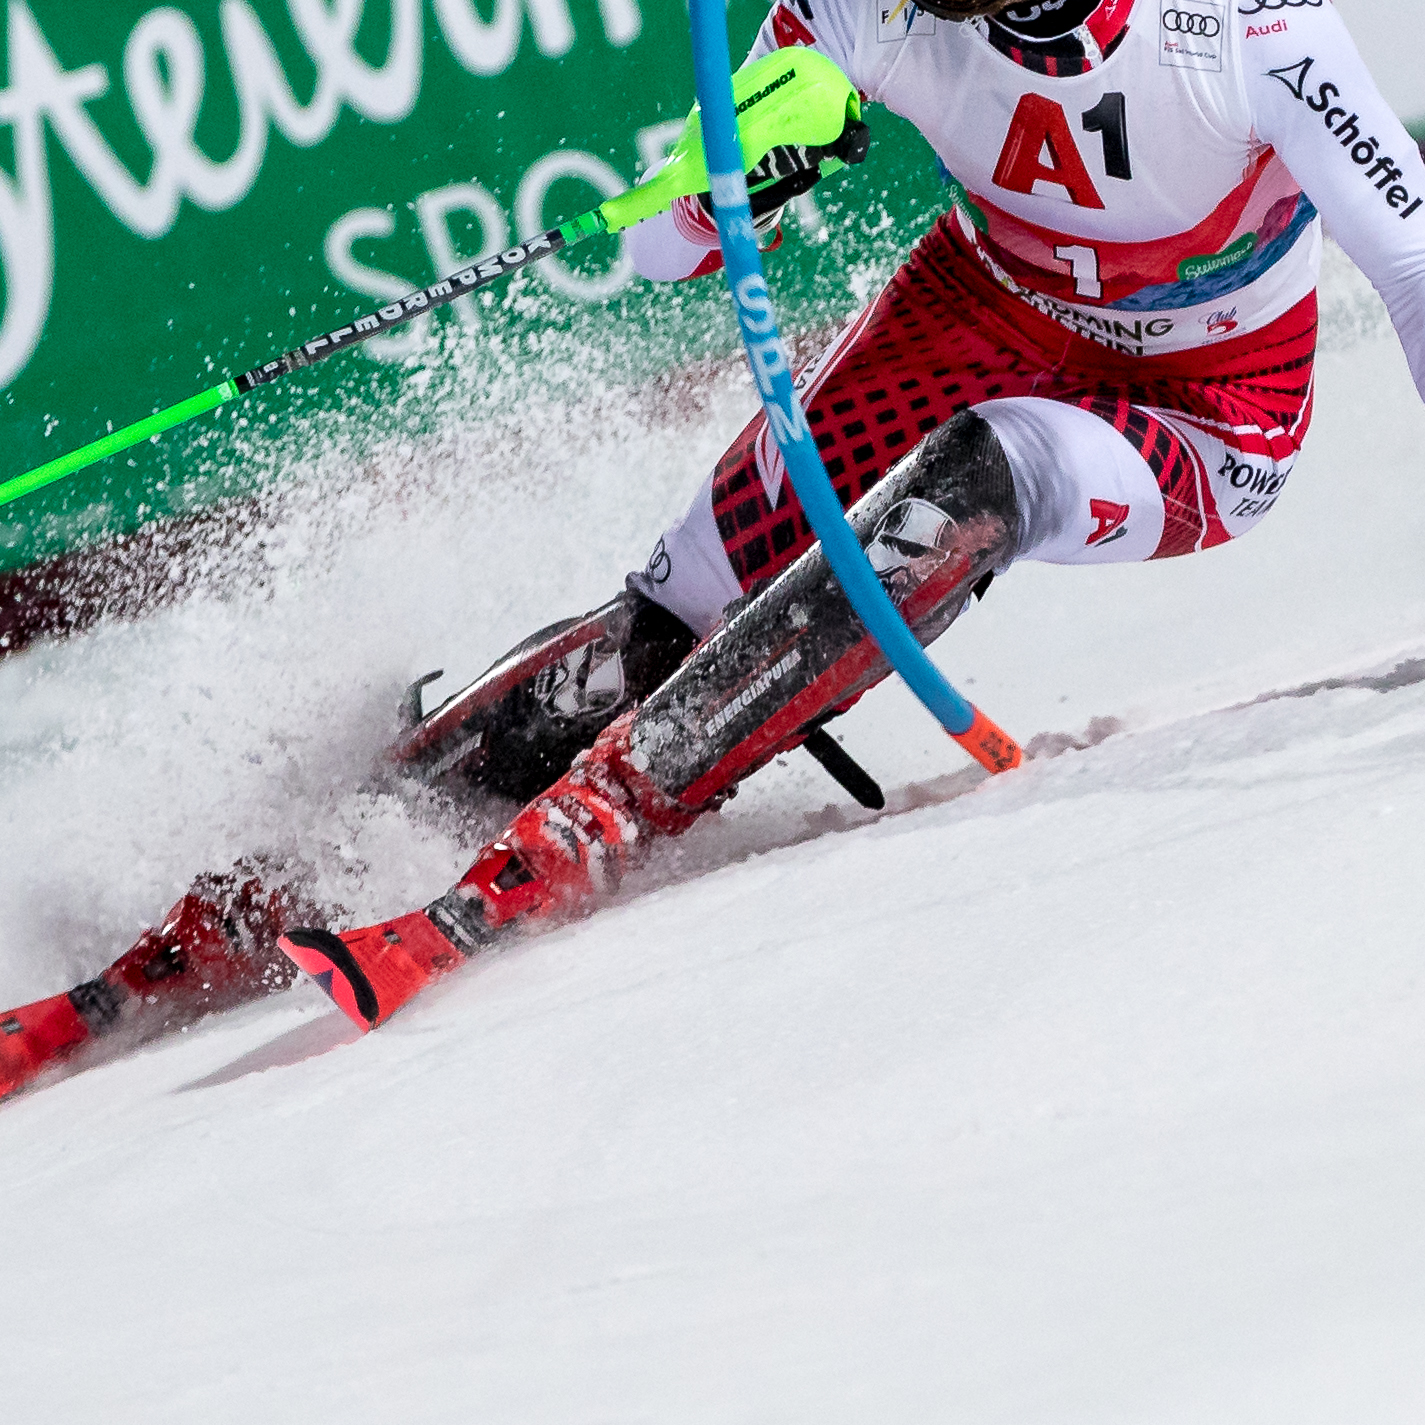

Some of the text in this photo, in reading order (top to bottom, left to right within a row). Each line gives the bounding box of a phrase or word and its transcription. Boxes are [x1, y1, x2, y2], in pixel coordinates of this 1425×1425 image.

[1244, 18, 1288, 40] Audi
[991, 91, 1133, 211] A1
[1305, 81, 1424, 220] Schöffel
[304, 235, 552, 356] KOMPERDELL
[1054, 244, 1102, 300] 1
